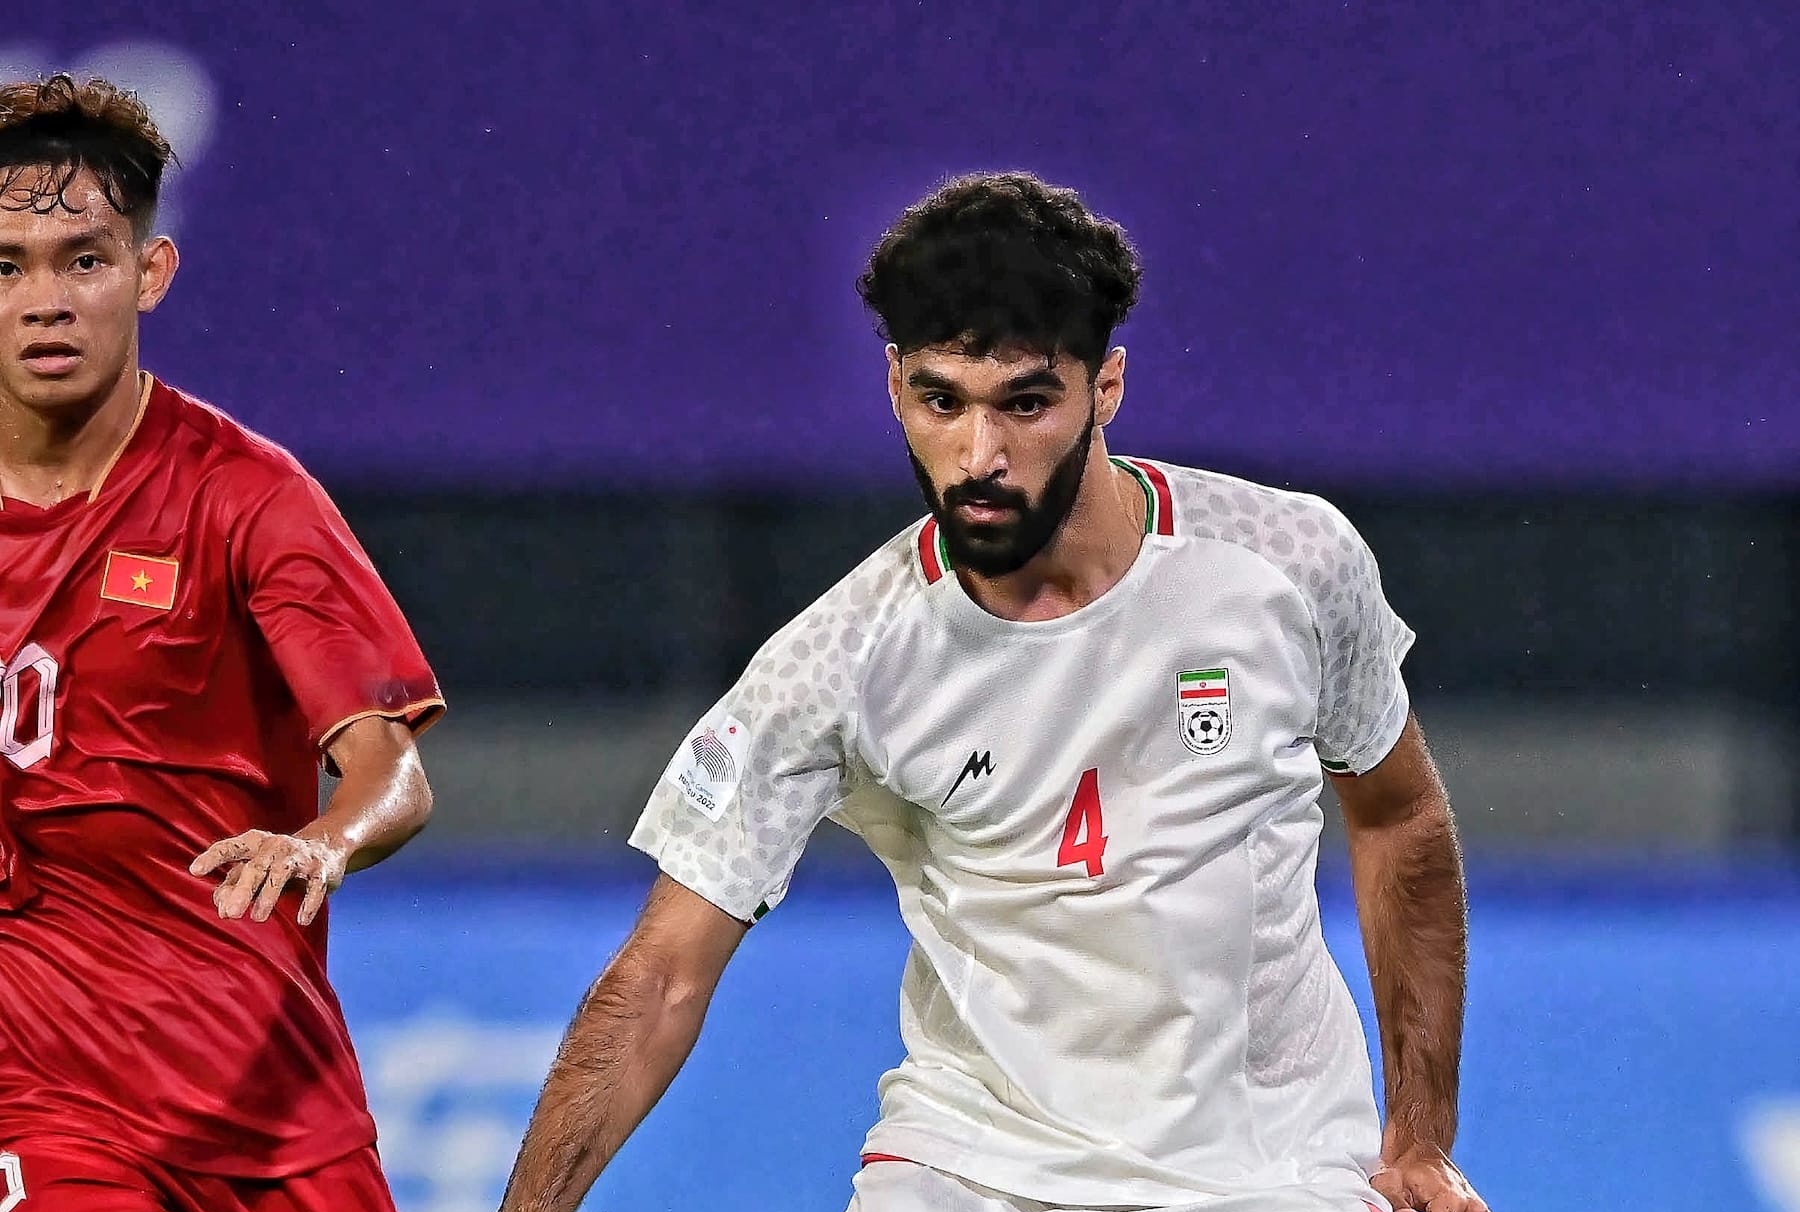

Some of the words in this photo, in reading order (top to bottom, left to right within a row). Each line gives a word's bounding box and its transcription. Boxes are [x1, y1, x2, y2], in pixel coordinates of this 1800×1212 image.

[0, 642, 59, 770] 0
[696, 794, 716, 811] 2022
[1057, 767, 1108, 878] 4
